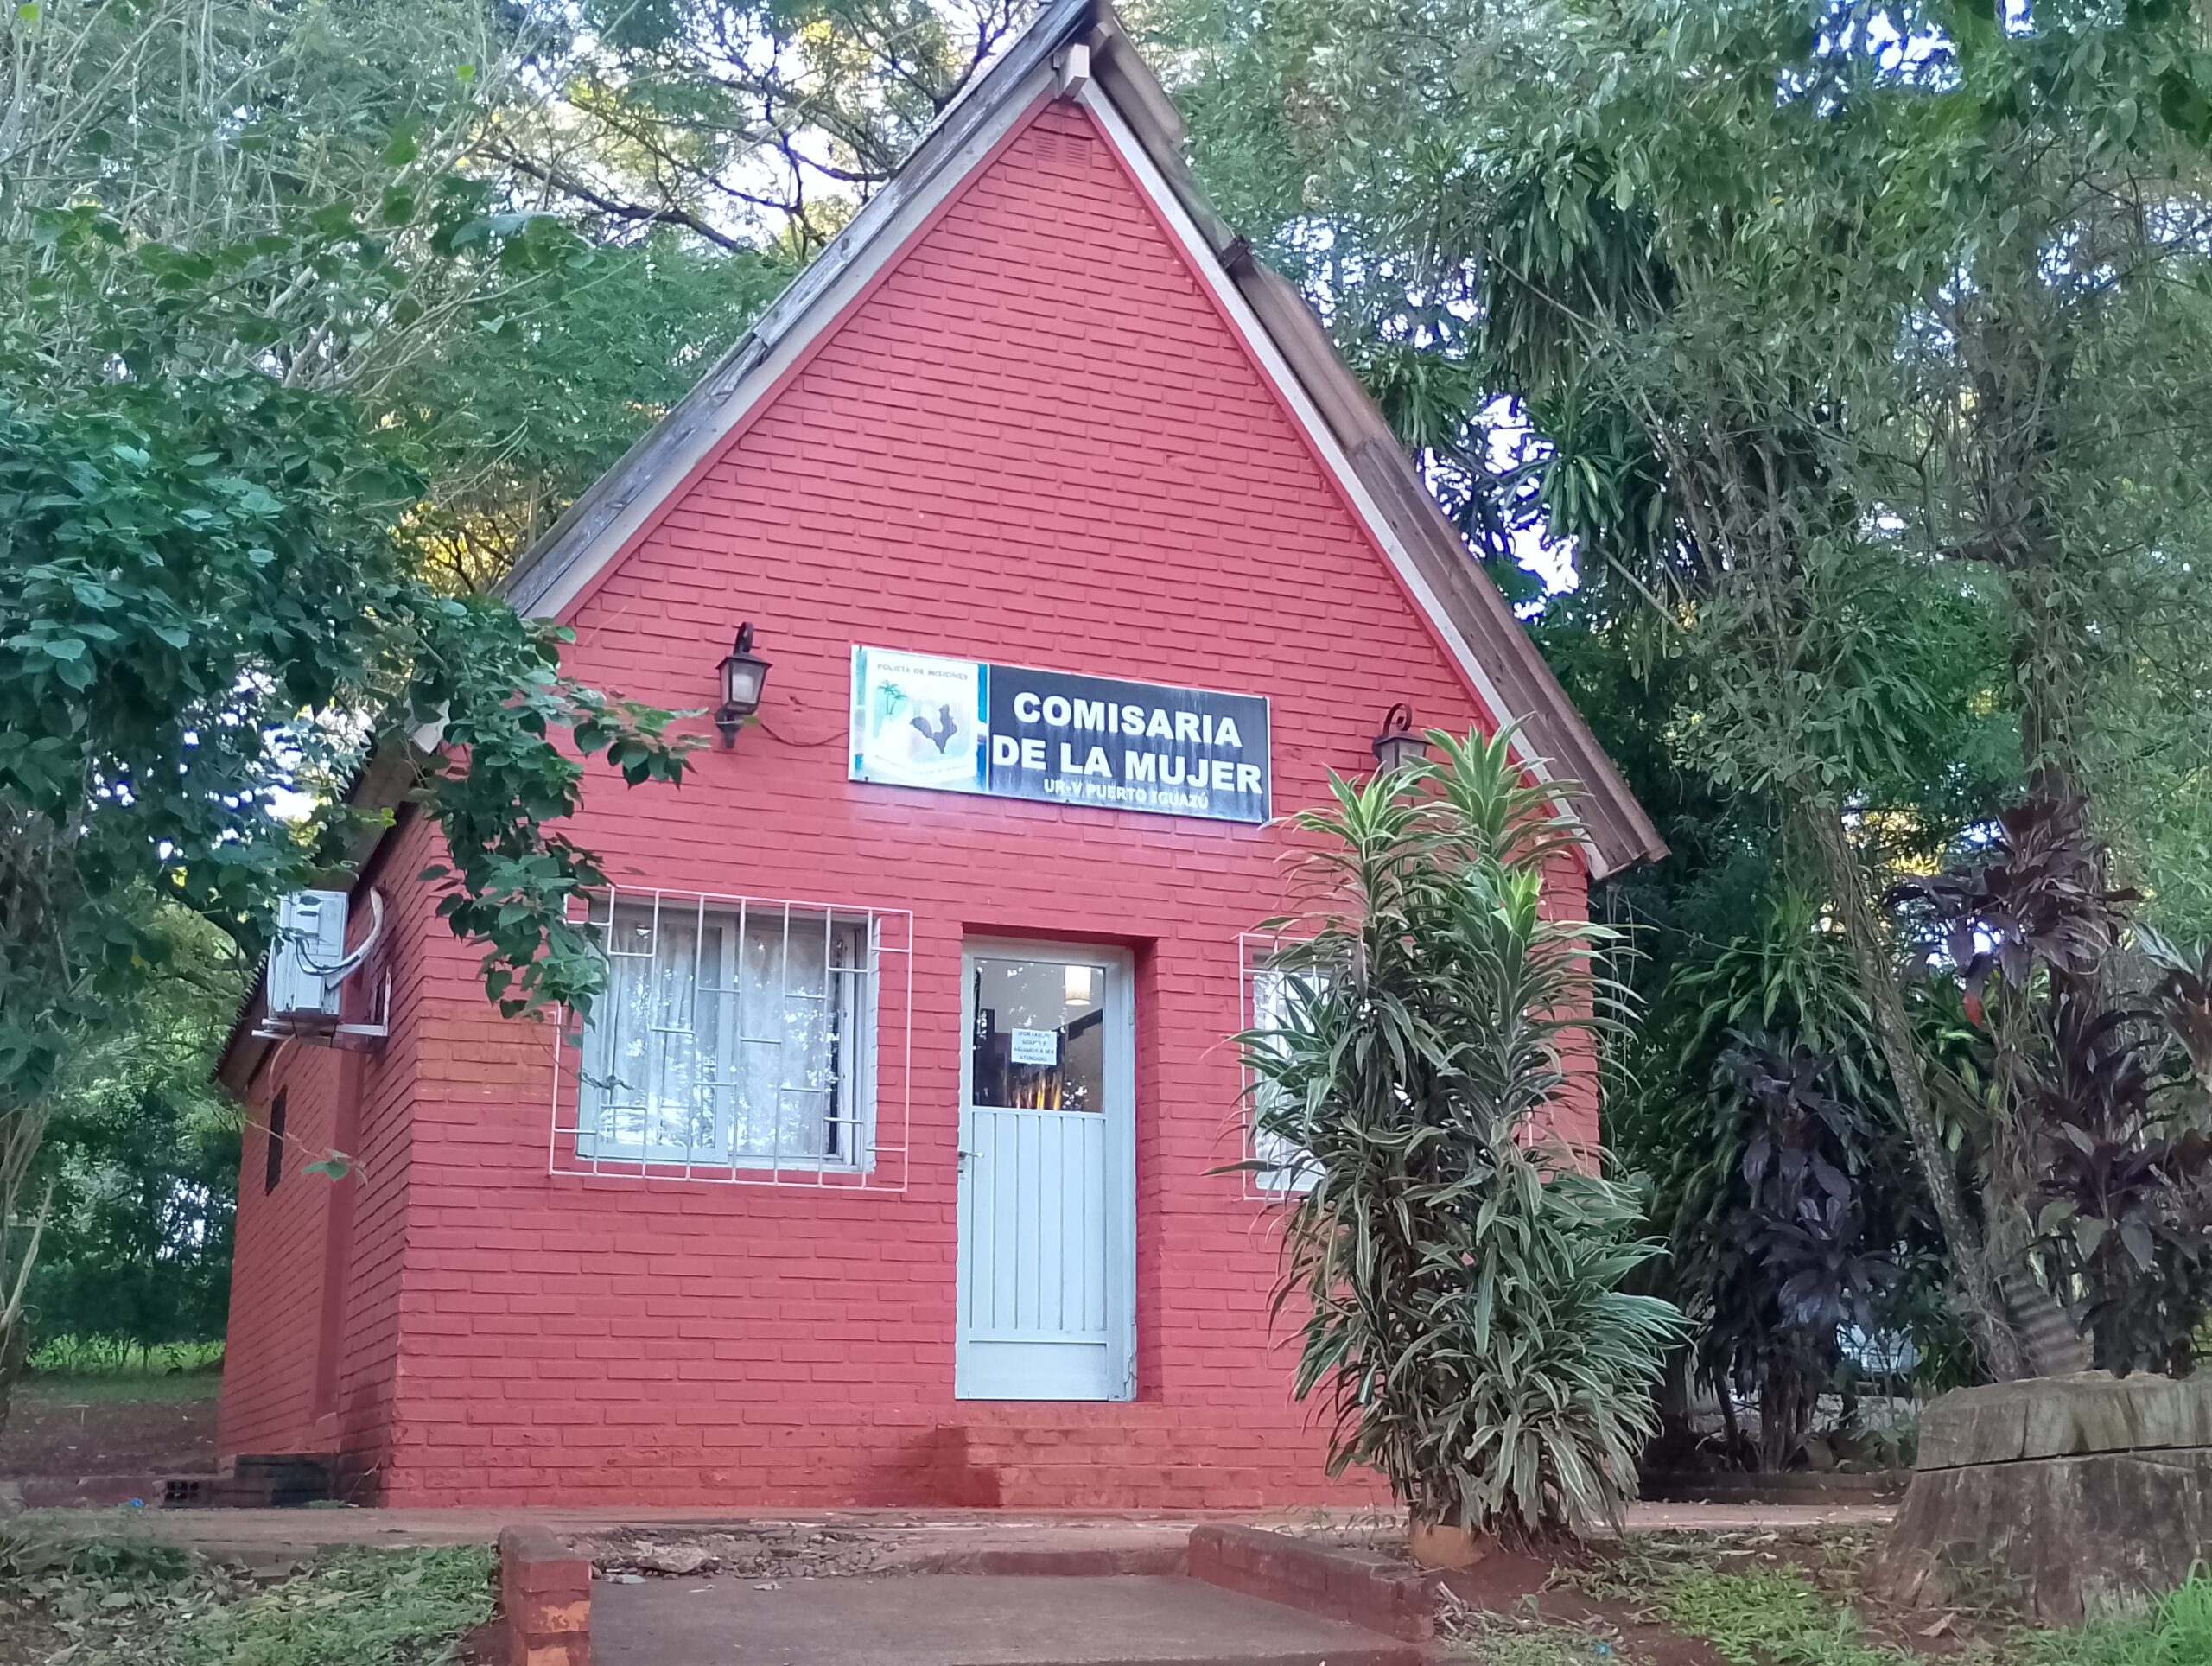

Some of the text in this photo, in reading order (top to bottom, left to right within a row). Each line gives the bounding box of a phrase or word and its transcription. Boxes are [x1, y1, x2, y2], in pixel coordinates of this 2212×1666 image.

[927, 670, 968, 680] MISIONES
[1013, 691, 1243, 747] COMISARIA
[992, 734, 1047, 771] DE
[1059, 741, 1113, 778] LA
[1125, 749, 1263, 794] MUJER
[1044, 778, 1209, 809] UR-V PUERTO IGUAZÚ
